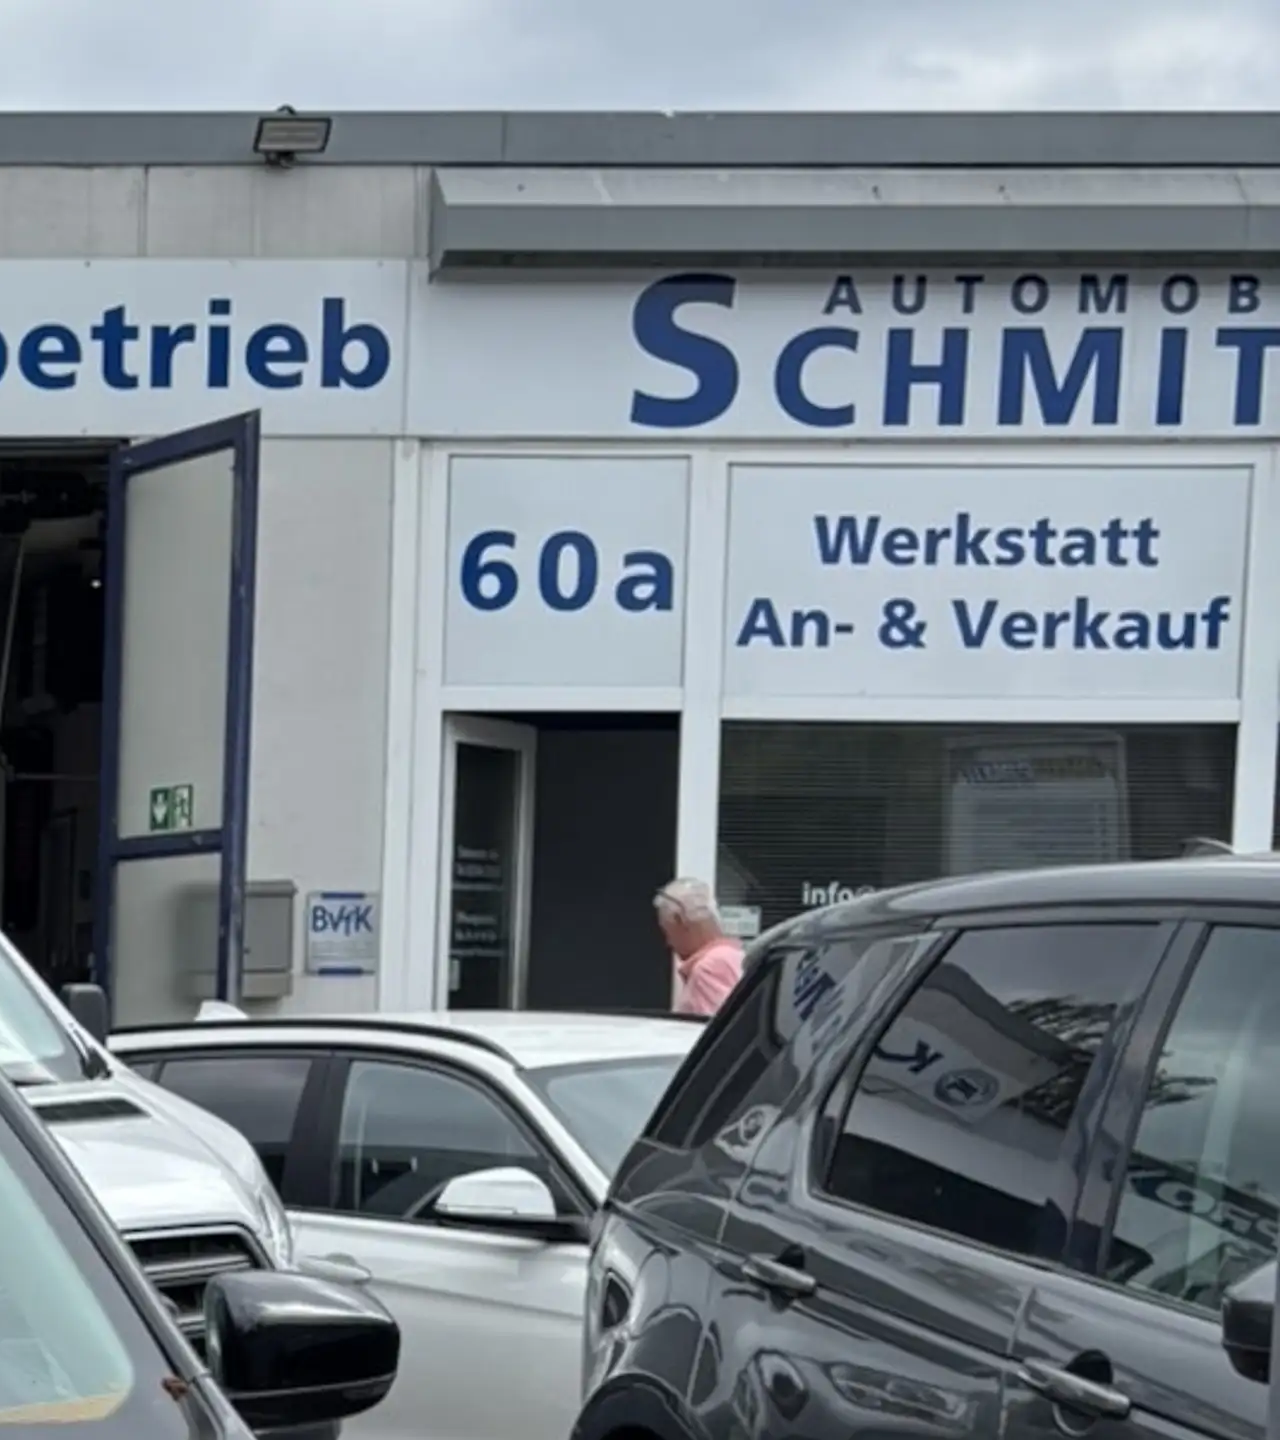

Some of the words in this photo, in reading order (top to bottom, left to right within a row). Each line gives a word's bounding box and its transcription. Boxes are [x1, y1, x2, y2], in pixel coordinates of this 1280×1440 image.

[824, 273, 1261, 315] AUTOMOB
[629, 273, 1280, 429] SCHMIT
[814, 512, 1161, 567] Werkstatt
[459, 529, 675, 613] 60a
[735, 597, 855, 649] An-
[877, 598, 927, 649] &
[951, 595, 1232, 650] Verkauf
[311, 904, 374, 937] BVfK
